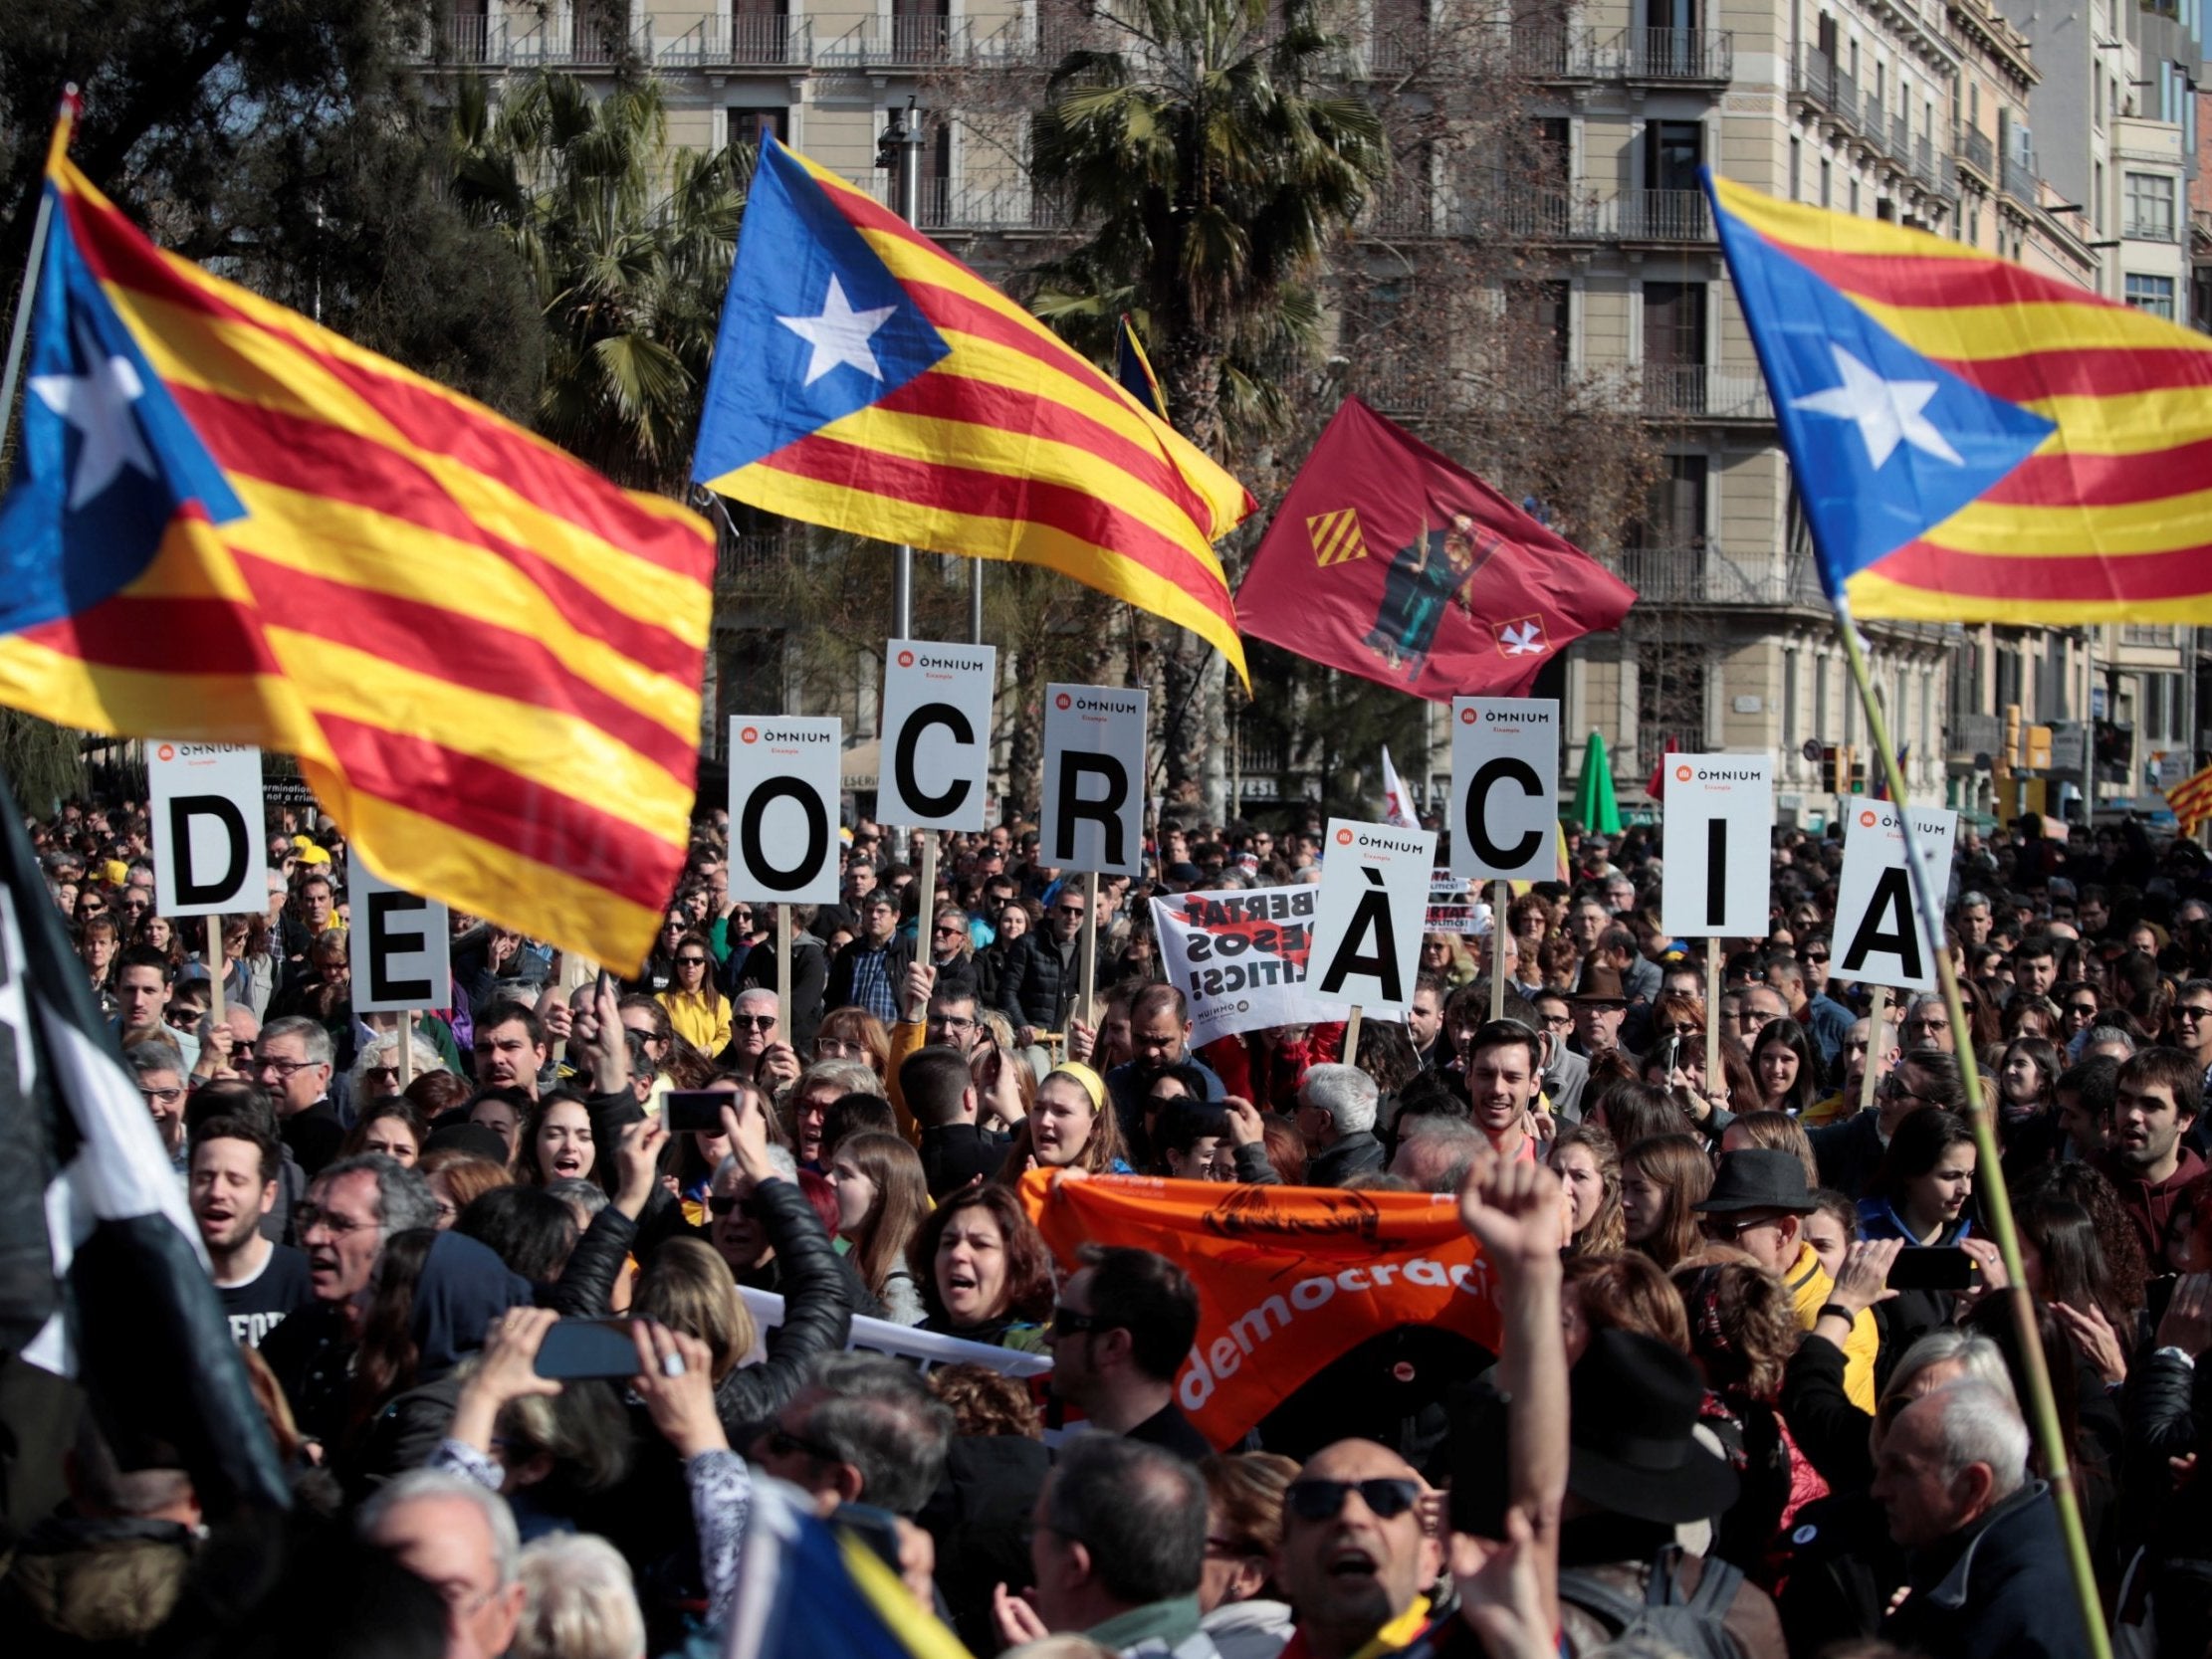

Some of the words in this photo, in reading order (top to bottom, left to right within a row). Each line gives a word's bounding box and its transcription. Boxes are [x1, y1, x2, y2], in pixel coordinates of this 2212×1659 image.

[920, 655, 984, 672] ÒMNIUM
[1076, 697, 1137, 714] ÒMNIUM
[1485, 710, 1549, 724] ÒMNIUM
[764, 729, 830, 743] ÒMNIUM
[895, 703, 975, 818] C
[1698, 768, 1761, 781] ÒMNIUM
[169, 795, 249, 906] D
[741, 775, 828, 892] O
[1056, 749, 1128, 866] R
[1359, 834, 1424, 855] ÒMNIUM
[1465, 756, 1544, 870] C
[1881, 814, 1946, 836] ÒMIUM
[1706, 818, 1727, 926] I
[1842, 867, 1923, 979] A
[368, 891, 432, 1002] E
[1319, 866, 1403, 1002] À
